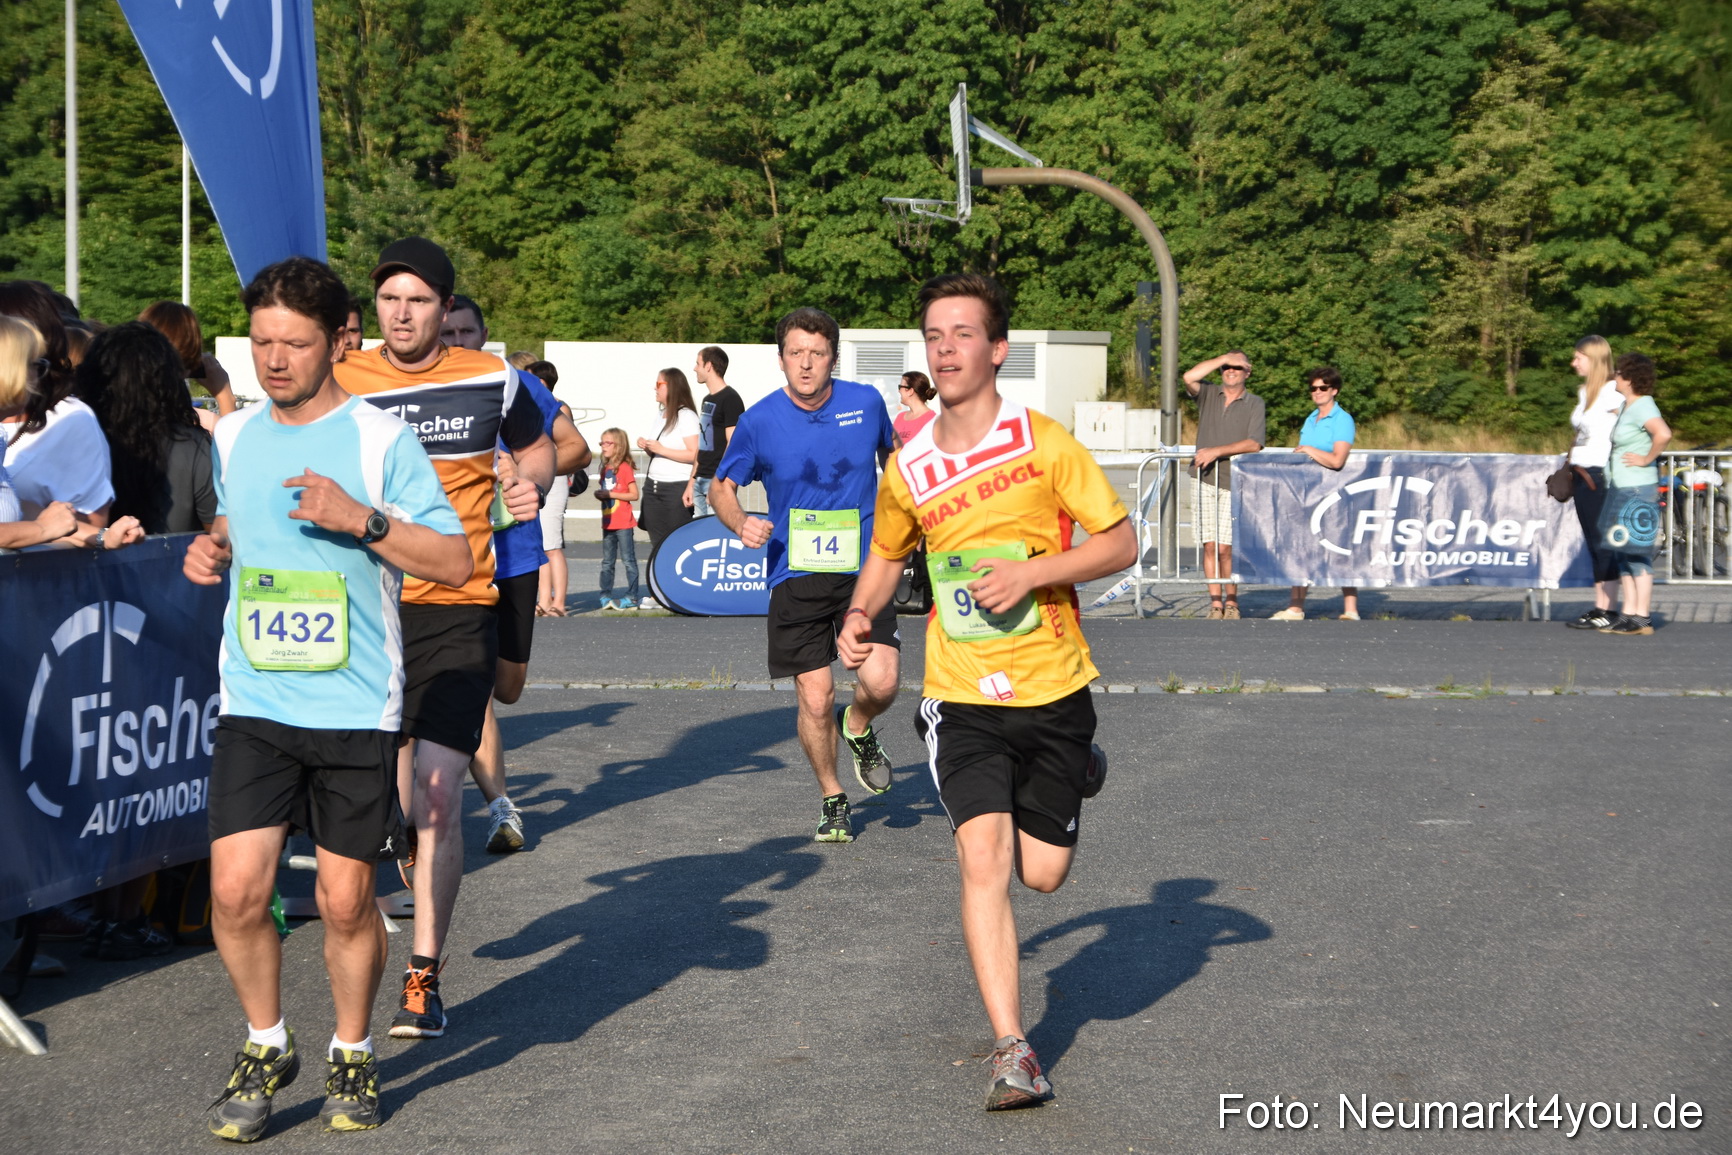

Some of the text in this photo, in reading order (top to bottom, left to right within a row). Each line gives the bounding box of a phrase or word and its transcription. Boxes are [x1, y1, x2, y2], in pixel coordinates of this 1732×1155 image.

[408, 415, 475, 434] scher
[418, 431, 470, 443] OMOBILE
[921, 461, 1045, 531] MAX BÖGL
[1352, 509, 1548, 547] Fischer
[811, 535, 840, 555] 14
[701, 557, 768, 580] Fisc
[1370, 551, 1531, 567] AUTOMOBILE
[713, 581, 768, 592] AUTOM
[247, 608, 335, 643] 1432
[68, 676, 222, 786] Fische
[79, 775, 209, 839] AUTOMOBI
